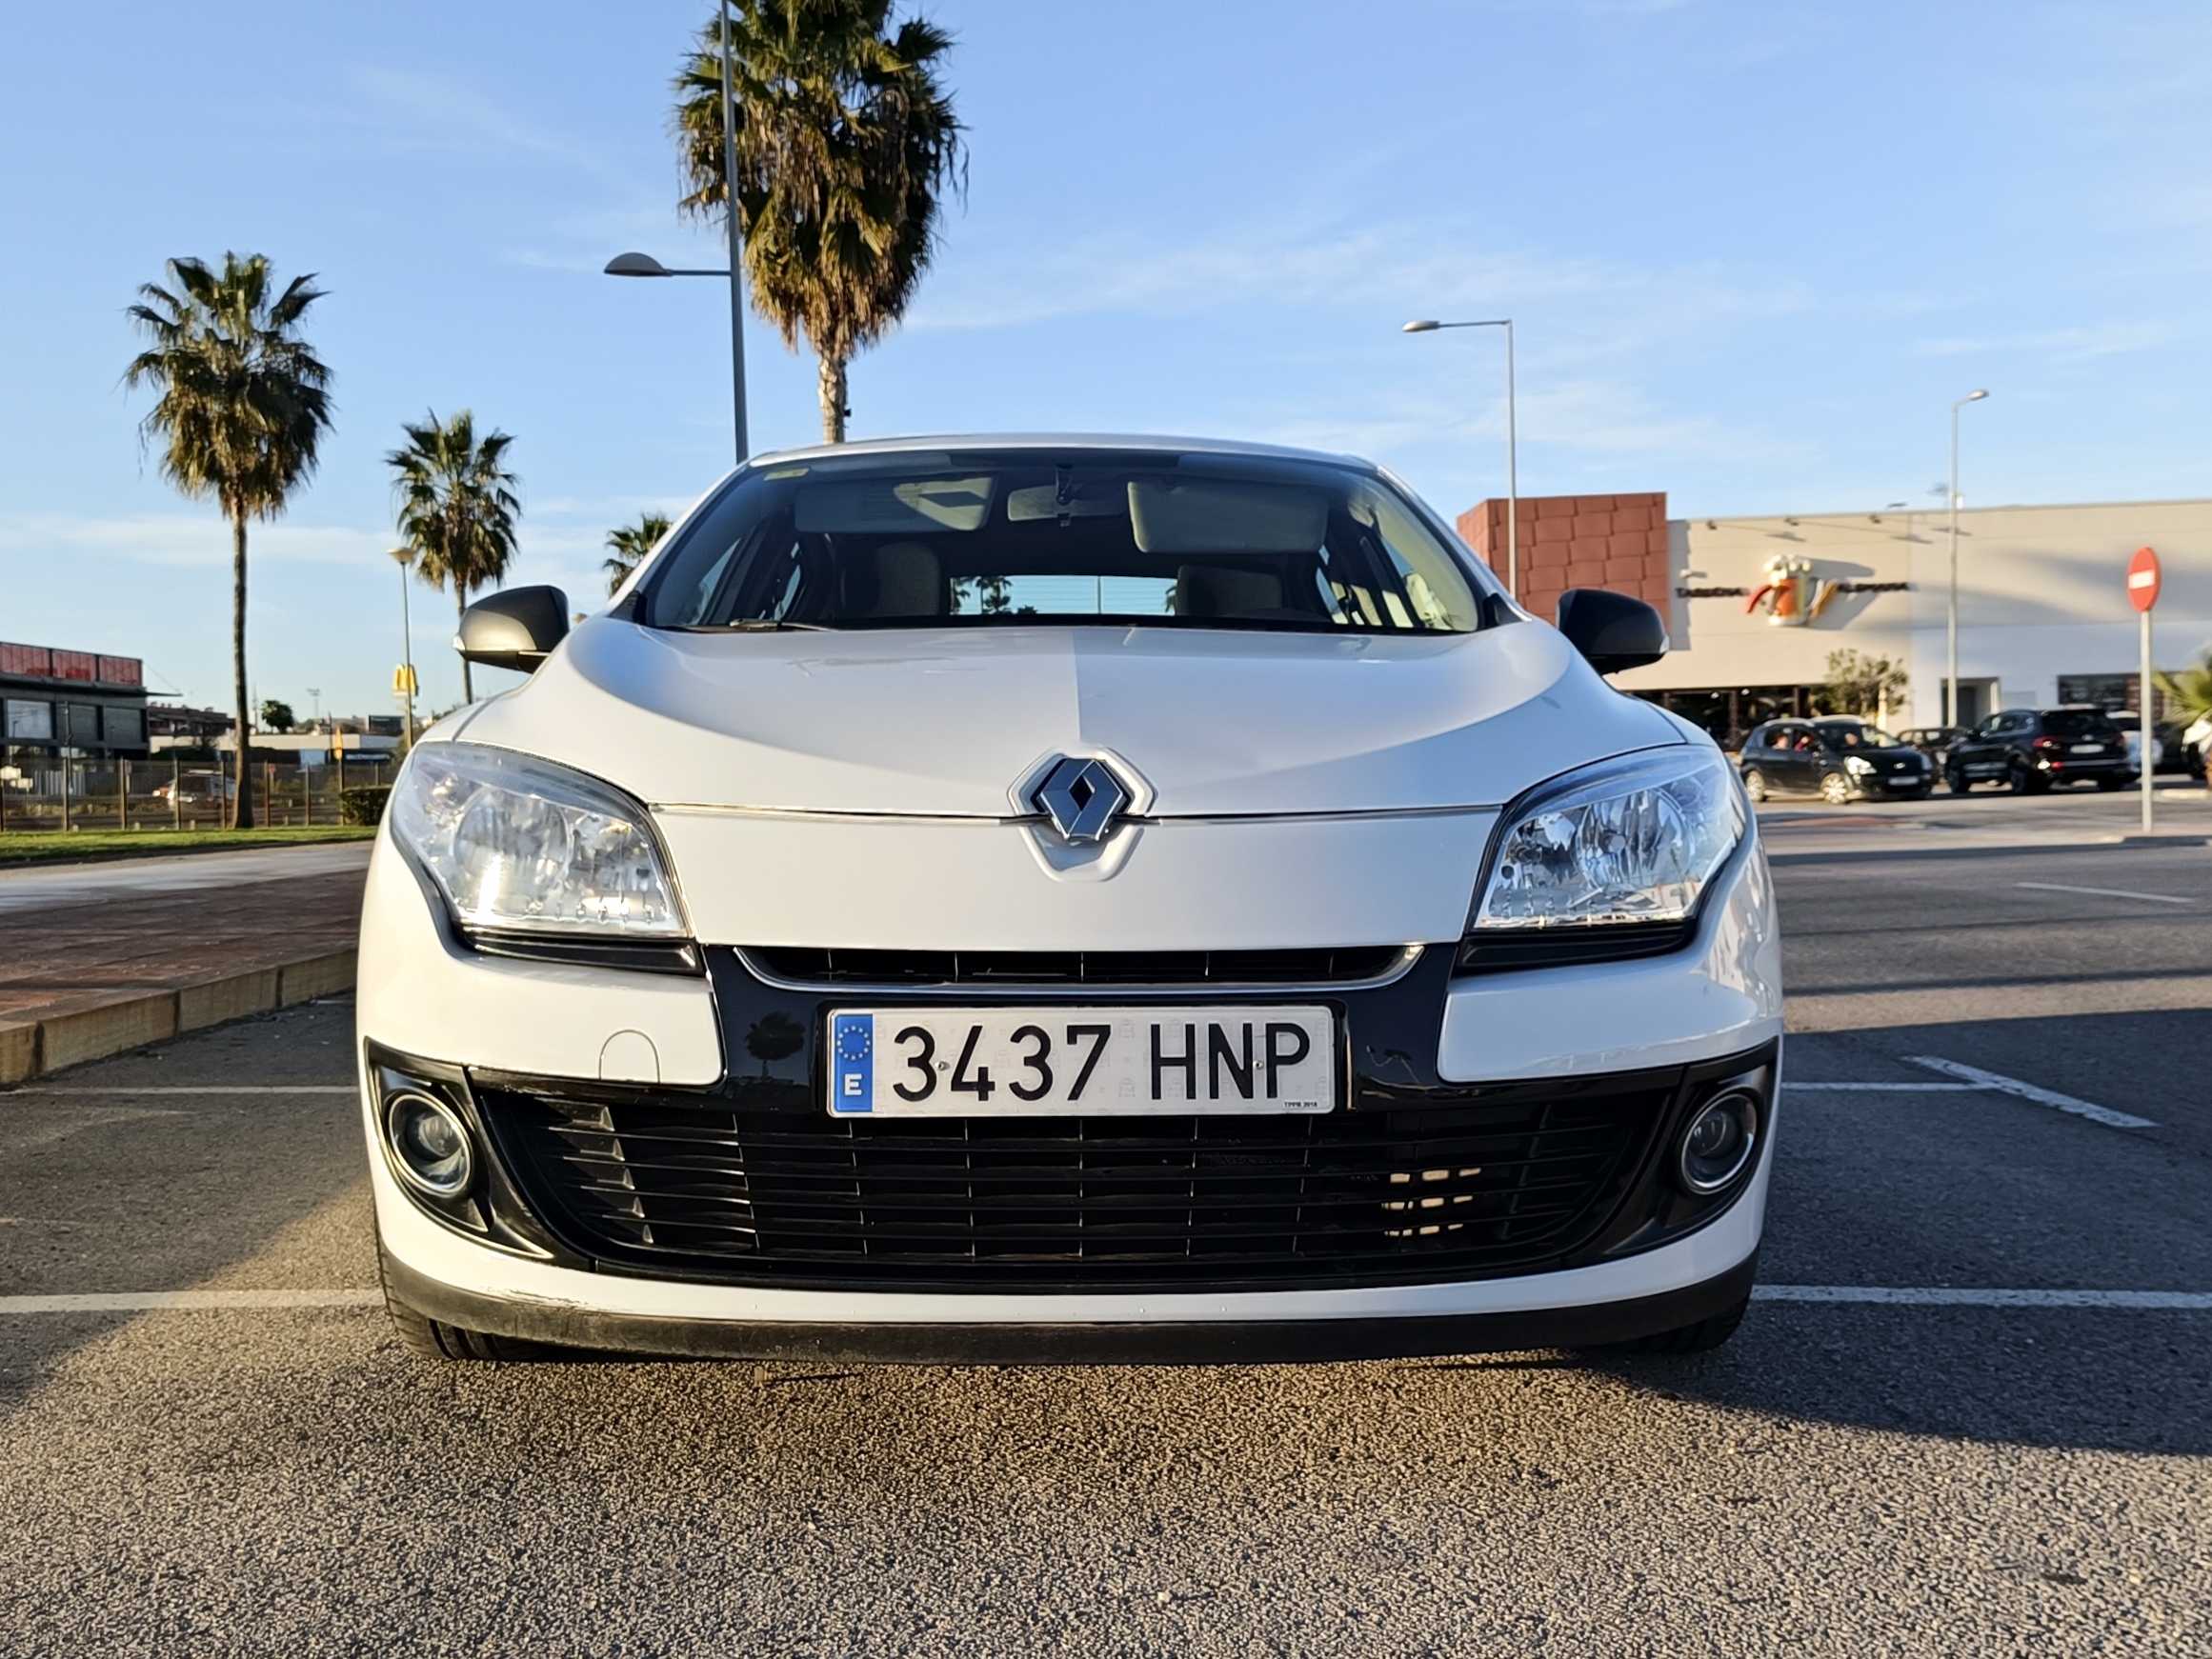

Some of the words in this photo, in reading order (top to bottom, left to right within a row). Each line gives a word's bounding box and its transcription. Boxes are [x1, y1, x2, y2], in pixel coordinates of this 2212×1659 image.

[844, 1073, 862, 1096] E
[893, 1025, 1111, 1102] 3437
[1151, 1023, 1311, 1100] HNP
